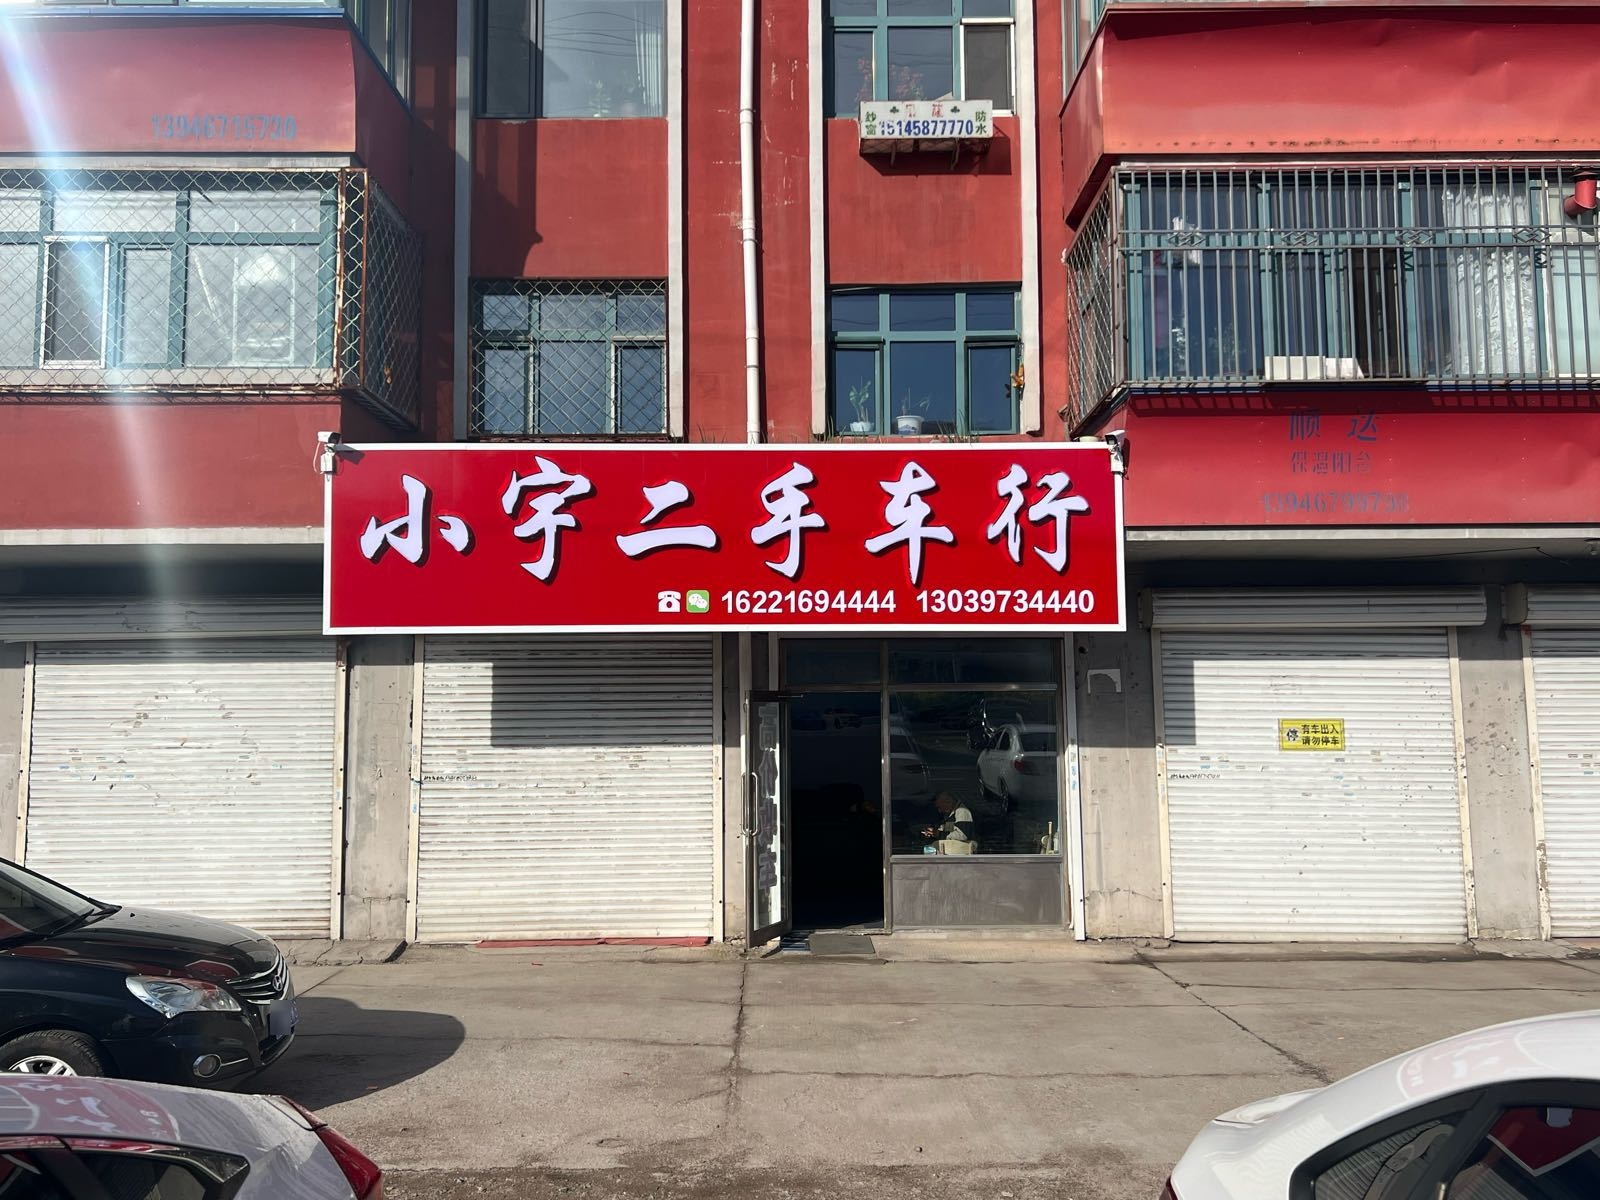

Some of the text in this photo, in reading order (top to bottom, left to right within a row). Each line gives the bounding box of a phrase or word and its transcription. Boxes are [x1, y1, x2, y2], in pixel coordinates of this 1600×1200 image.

[879, 120, 974, 136] 15145877770
[975, 111, 987, 134] 防水
[1289, 410, 1377, 441] 顺达
[361, 456, 1090, 584] 小宇二手车行
[721, 589, 1095, 614] 16221694444 13039734440
[1301, 724, 1339, 734] 有车出入
[1302, 735, 1340, 746] 请勿停车
